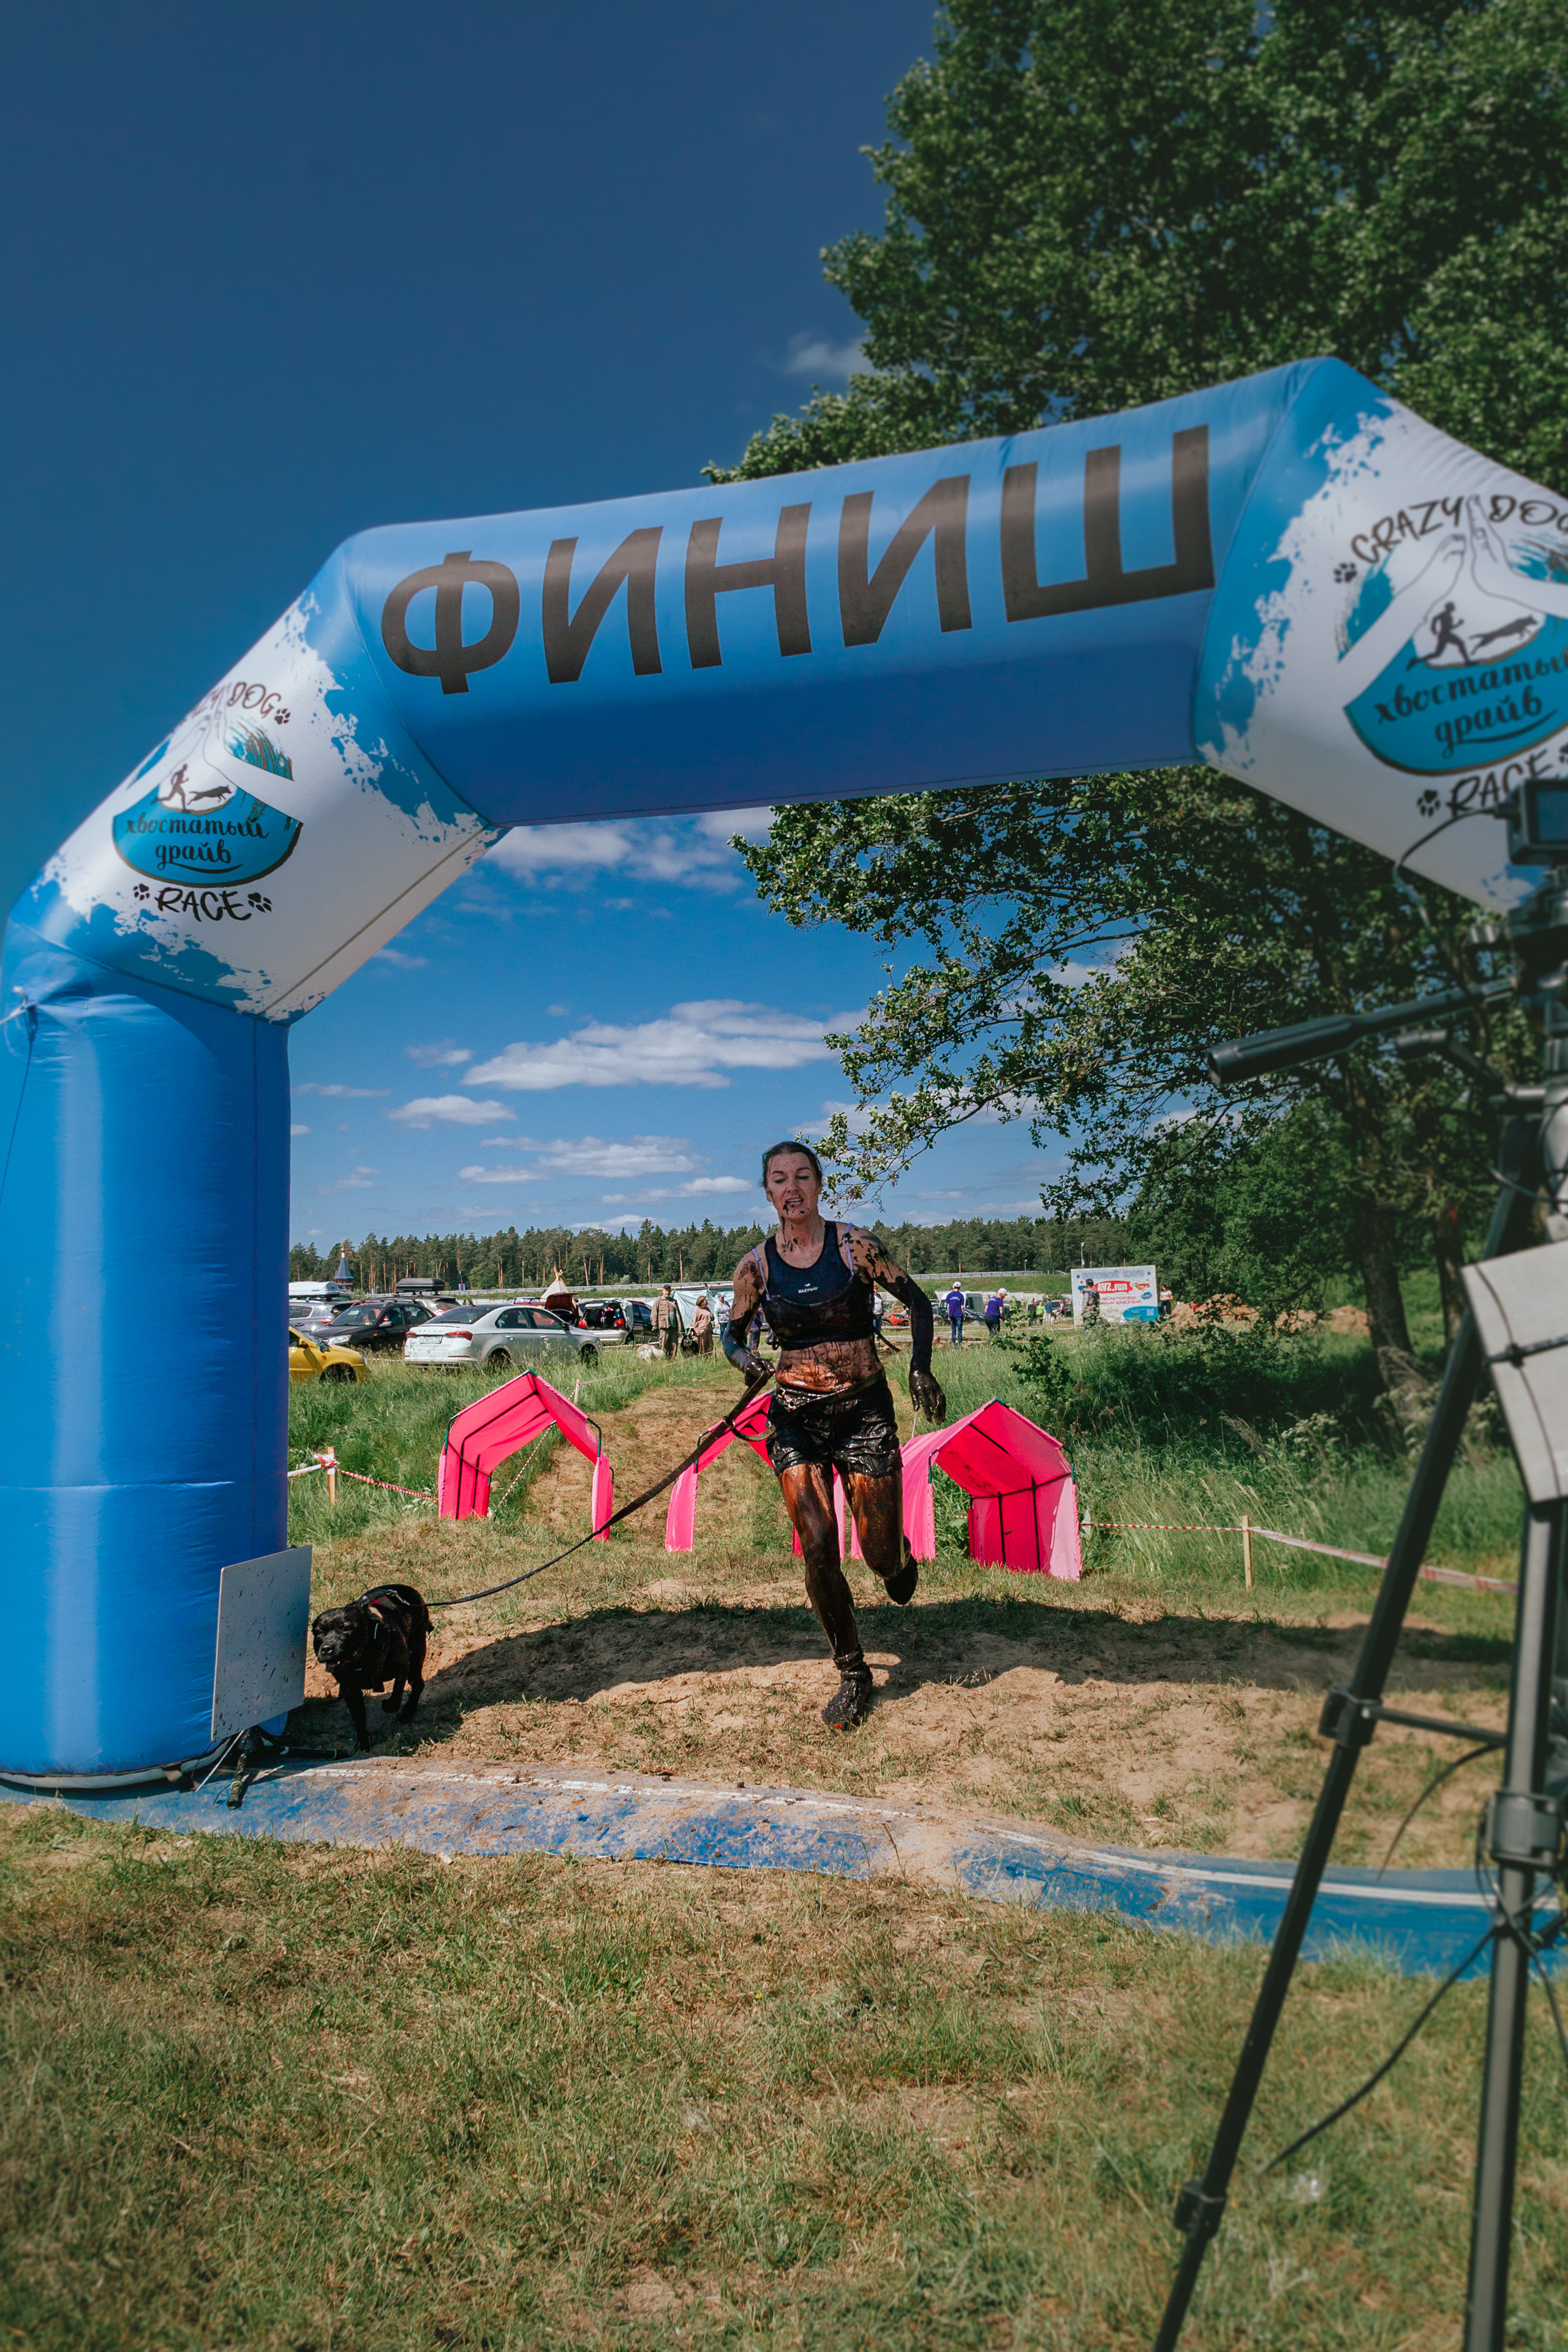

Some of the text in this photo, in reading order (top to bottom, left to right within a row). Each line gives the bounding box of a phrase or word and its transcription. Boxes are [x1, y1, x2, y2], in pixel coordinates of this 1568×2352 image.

[1351, 496, 1464, 564] CRAZY
[381, 424, 1215, 695] ФИНИШ
[227, 681, 282, 719] DOG
[1374, 655, 1568, 726] хвостаты
[1434, 684, 1545, 760] драйв
[125, 812, 271, 839] хвостатый
[156, 839, 235, 871] драйв
[154, 886, 252, 922] RACE
[1082, 1269, 1145, 1280] БЕГОВОЙ КЛУБ
